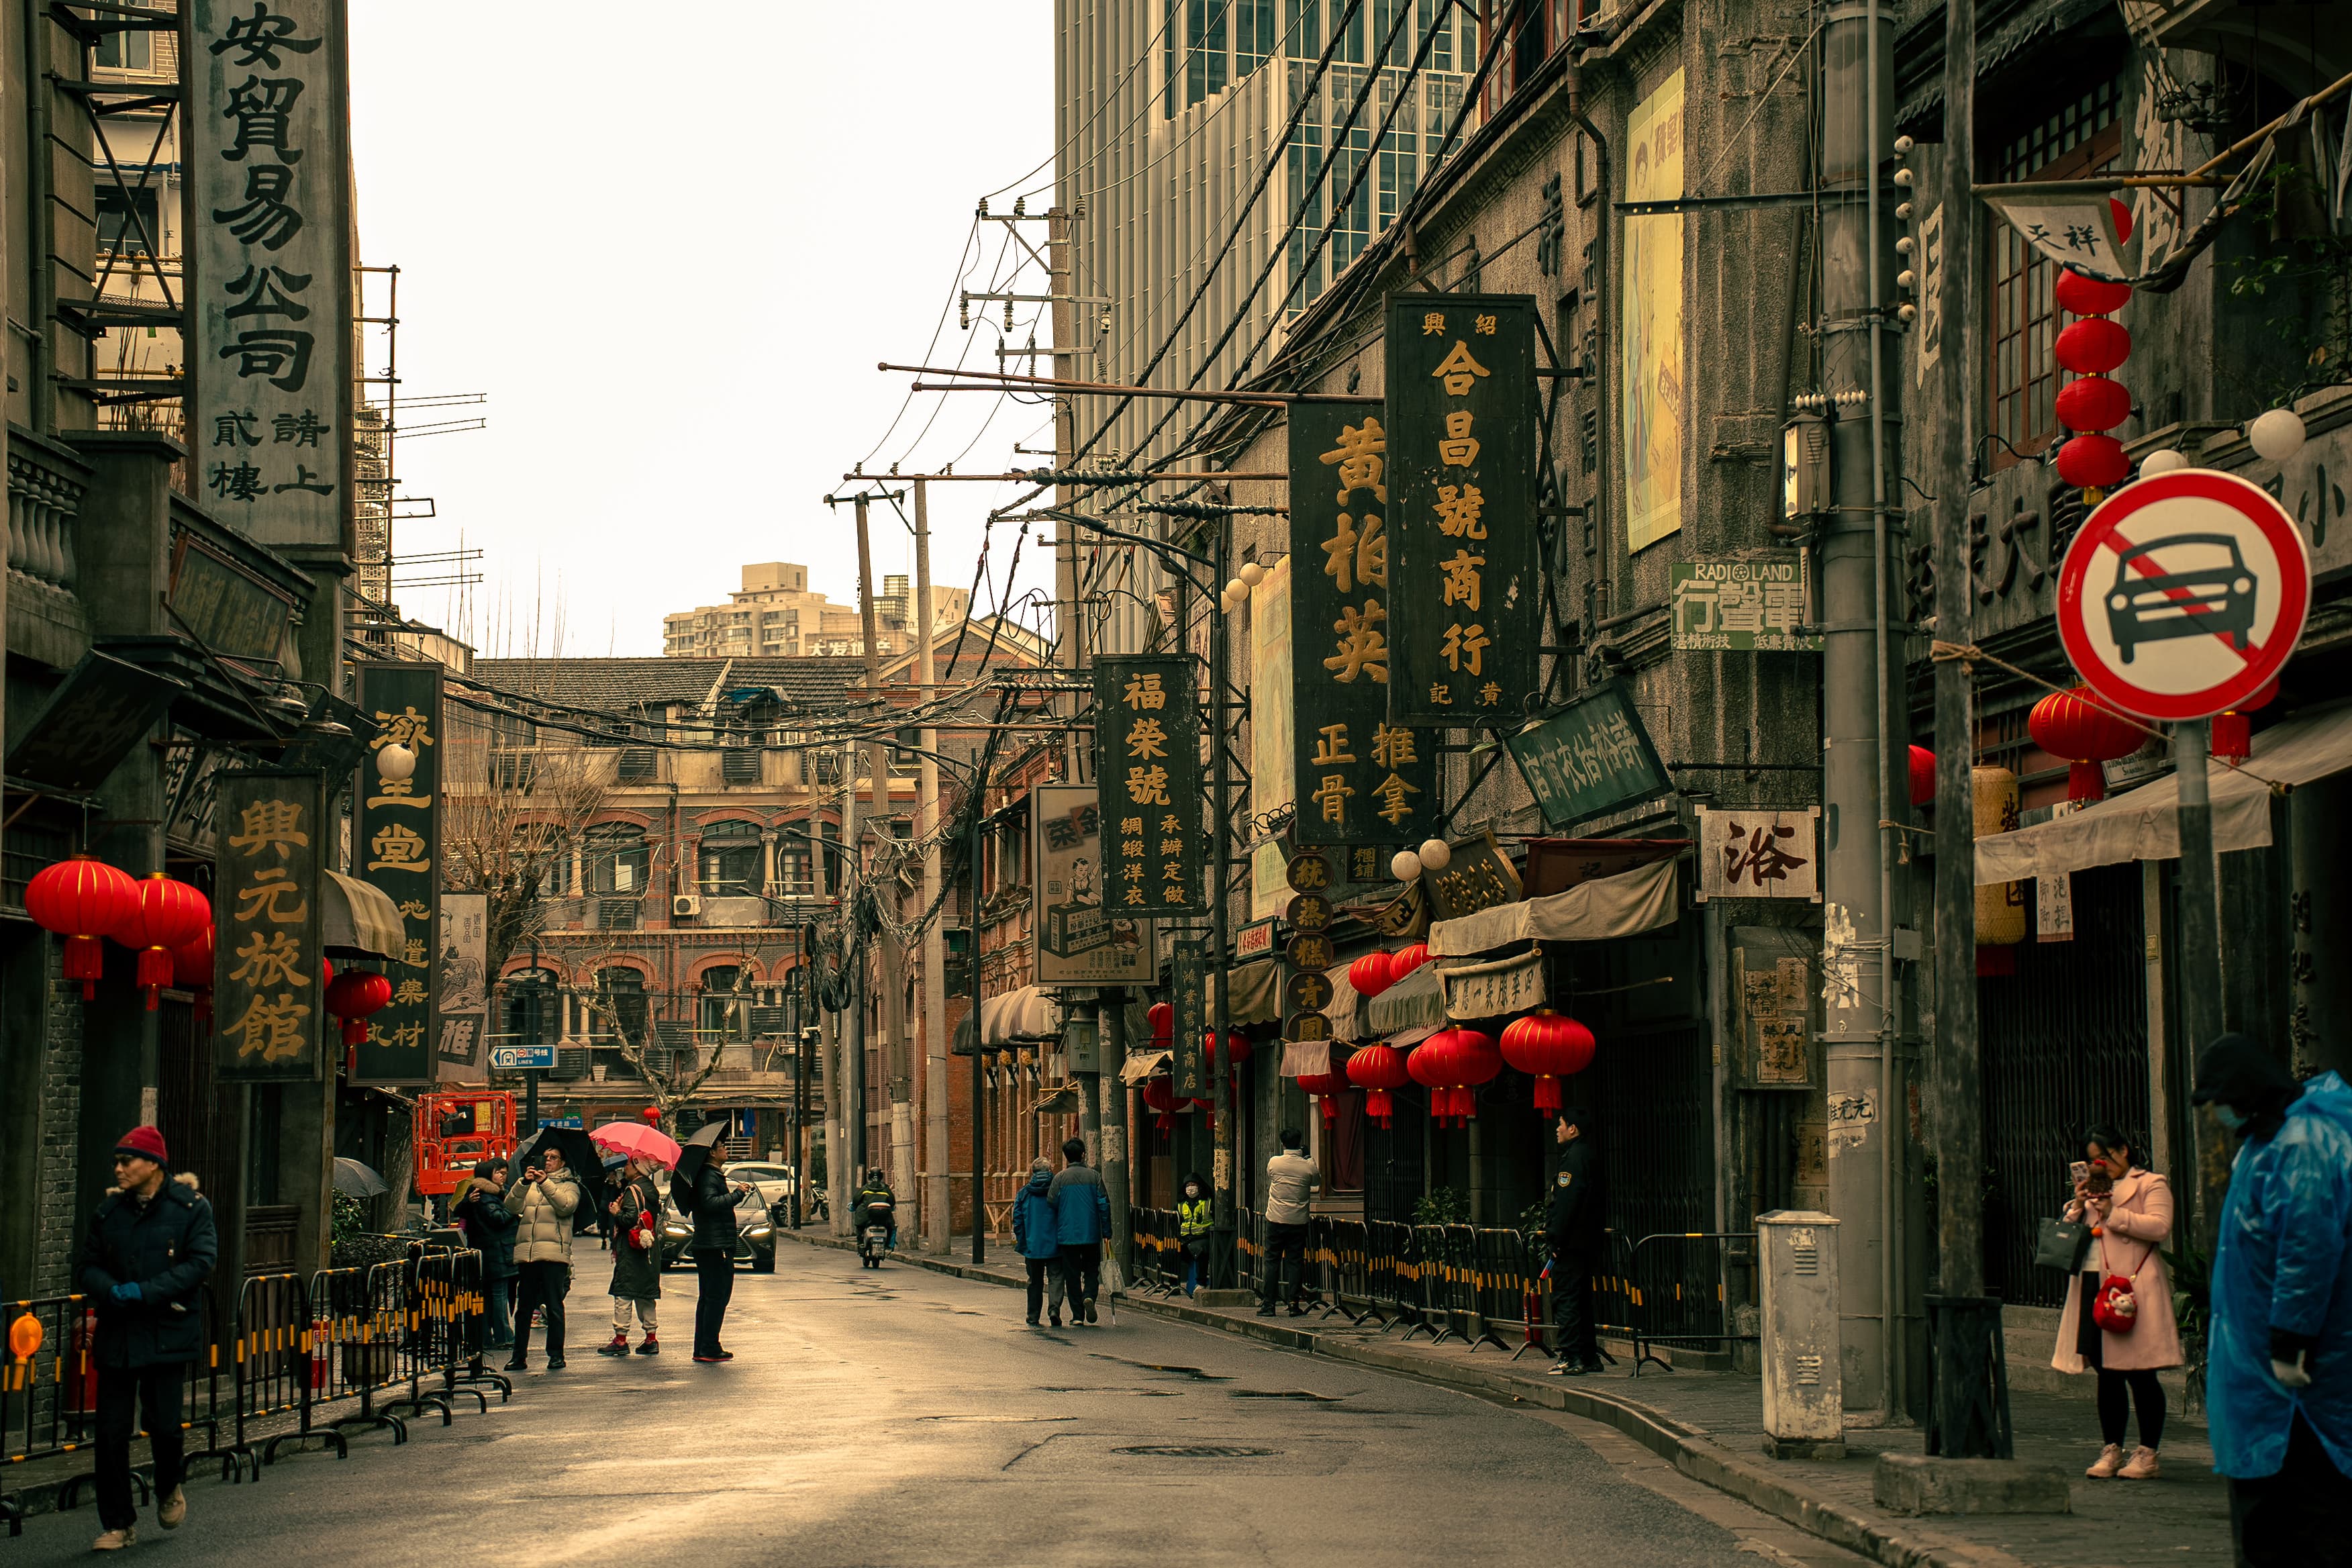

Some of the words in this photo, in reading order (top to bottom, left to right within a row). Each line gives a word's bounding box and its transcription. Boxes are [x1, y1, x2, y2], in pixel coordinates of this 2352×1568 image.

[209, 1, 323, 392] 安貿易公司
[1431, 339, 1491, 677] 合昌號商行
[1122, 672, 1172, 806] 福榮號
[222, 799, 313, 1062] 興元旅館
[1120, 816, 1146, 906] 綢緞洋衣
[1160, 814, 1187, 904] 承辦定做
[1724, 820, 1808, 887] 浴
[1293, 844, 1327, 1041] 統蒸糕青團
